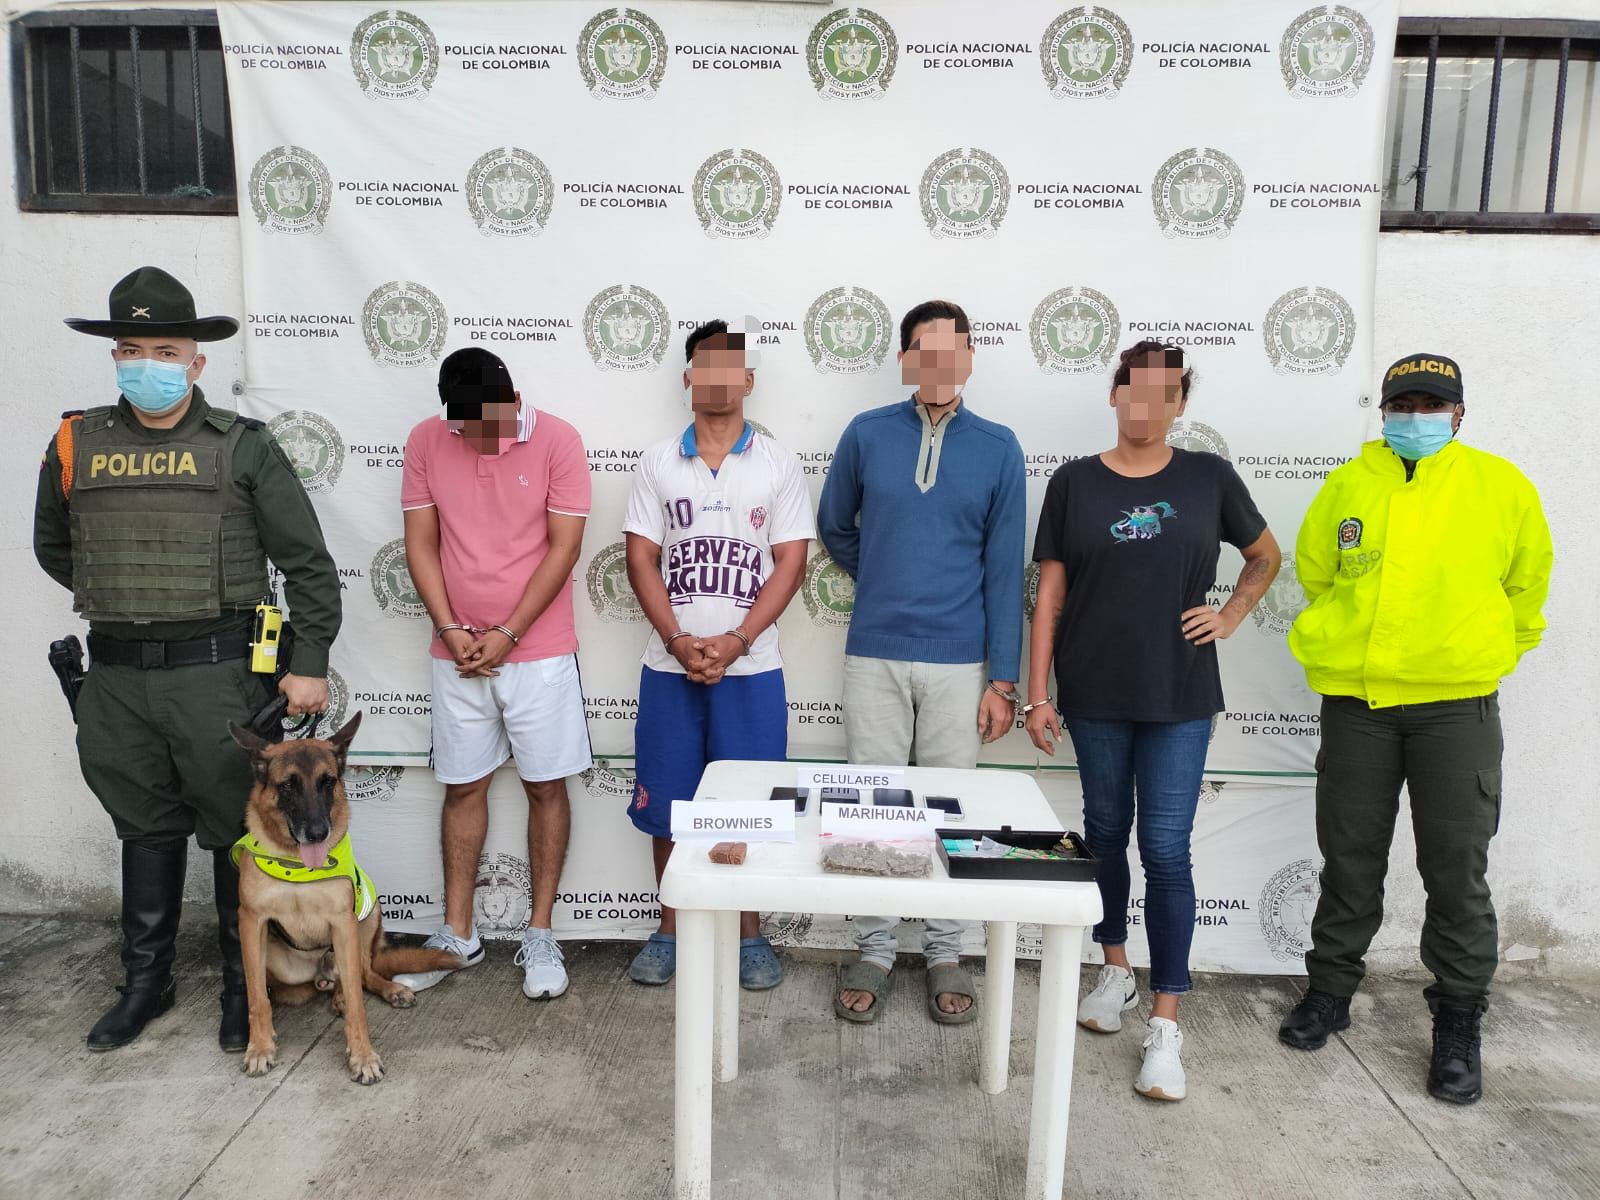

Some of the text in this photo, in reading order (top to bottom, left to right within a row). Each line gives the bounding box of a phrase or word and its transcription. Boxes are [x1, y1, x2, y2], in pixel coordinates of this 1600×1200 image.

[866, 23, 887, 59] COLOMBIA
[224, 43, 342, 56] POLICÍA NACIONAL
[444, 44, 566, 56] POLICÍA NACIONAL
[676, 44, 800, 54] POLICÍA NACIONAL
[906, 42, 1032, 54] POLICÍA NACIONAL
[1142, 40, 1270, 54] POLICÍA NACIONAL
[242, 58, 326, 70] DE COLOMBIA
[462, 60, 550, 70] DE COLOMBIA
[692, 60, 782, 70] DE COLOMBIA
[924, 58, 1014, 68] DE COLOMBIA
[1160, 58, 1252, 68] DE COLOMBIA
[852, 68, 883, 89] NACIONAL
[338, 180, 460, 192] POLICÍA NACIONAL
[564, 182, 684, 194] POLICÍA NACIONAL
[788, 182, 910, 194] POLICÍA NACIONAL
[1018, 182, 1142, 194] POLICÍA NACIONAL
[1254, 182, 1380, 194] POLICÍA NACIONAL
[356, 196, 442, 206] DE COLOMBIA
[580, 198, 668, 208] DE COLOMBIA
[804, 200, 894, 208] DE COLOMBIA
[1034, 198, 1124, 208] DE COLOMBIA
[1270, 198, 1362, 208] DE COLOMBIA
[248, 312, 356, 324] OLICÍA NACIONAL
[454, 316, 574, 328] POLICÍA NACIONAL
[762, 322, 797, 332] ONAL
[973, 322, 1022, 332] CIONAL
[1128, 320, 1254, 332] POLICÍA NACIONAL
[256, 328, 340, 338] DE COLOMBIA
[470, 330, 556, 342] DE COLOMBIA
[974, 336, 1004, 346] MBIA
[1167, 336, 1236, 346] COLOMBIA
[1388, 360, 1456, 380] POLICIA
[350, 444, 399, 455] POLICÍA
[586, 448, 618, 459] LICÍA
[90, 450, 197, 478] POLICIA
[367, 458, 383, 468] DE
[1026, 453, 1058, 464] LICÍA
[1238, 455, 1353, 466] POLICÍA NACIONA
[605, 464, 637, 472] COLO
[803, 466, 819, 474] DE
[1255, 470, 1330, 480] DE COLOMB
[664, 497, 693, 530] 10
[669, 539, 761, 576] CERVEZA
[668, 566, 761, 600] AGUILA
[355, 692, 402, 702] POLICÍA
[370, 706, 432, 716] DE COLOM
[586, 710, 639, 720] DE COLO
[799, 716, 814, 724] DE
[1226, 710, 1320, 724] POLICÍA NACIO
[1242, 726, 1320, 737] DE COLOMBI
[813, 774, 889, 786] CELULARES
[838, 808, 926, 822] MARIHUANA
[693, 818, 772, 830] BROWNIES
[509, 869, 532, 909] COLOMBIA
[377, 894, 434, 905] CIONAL
[554, 890, 613, 904] POLICÍA
[381, 910, 414, 920] MBIA
[574, 910, 661, 920] DE COLOMB
